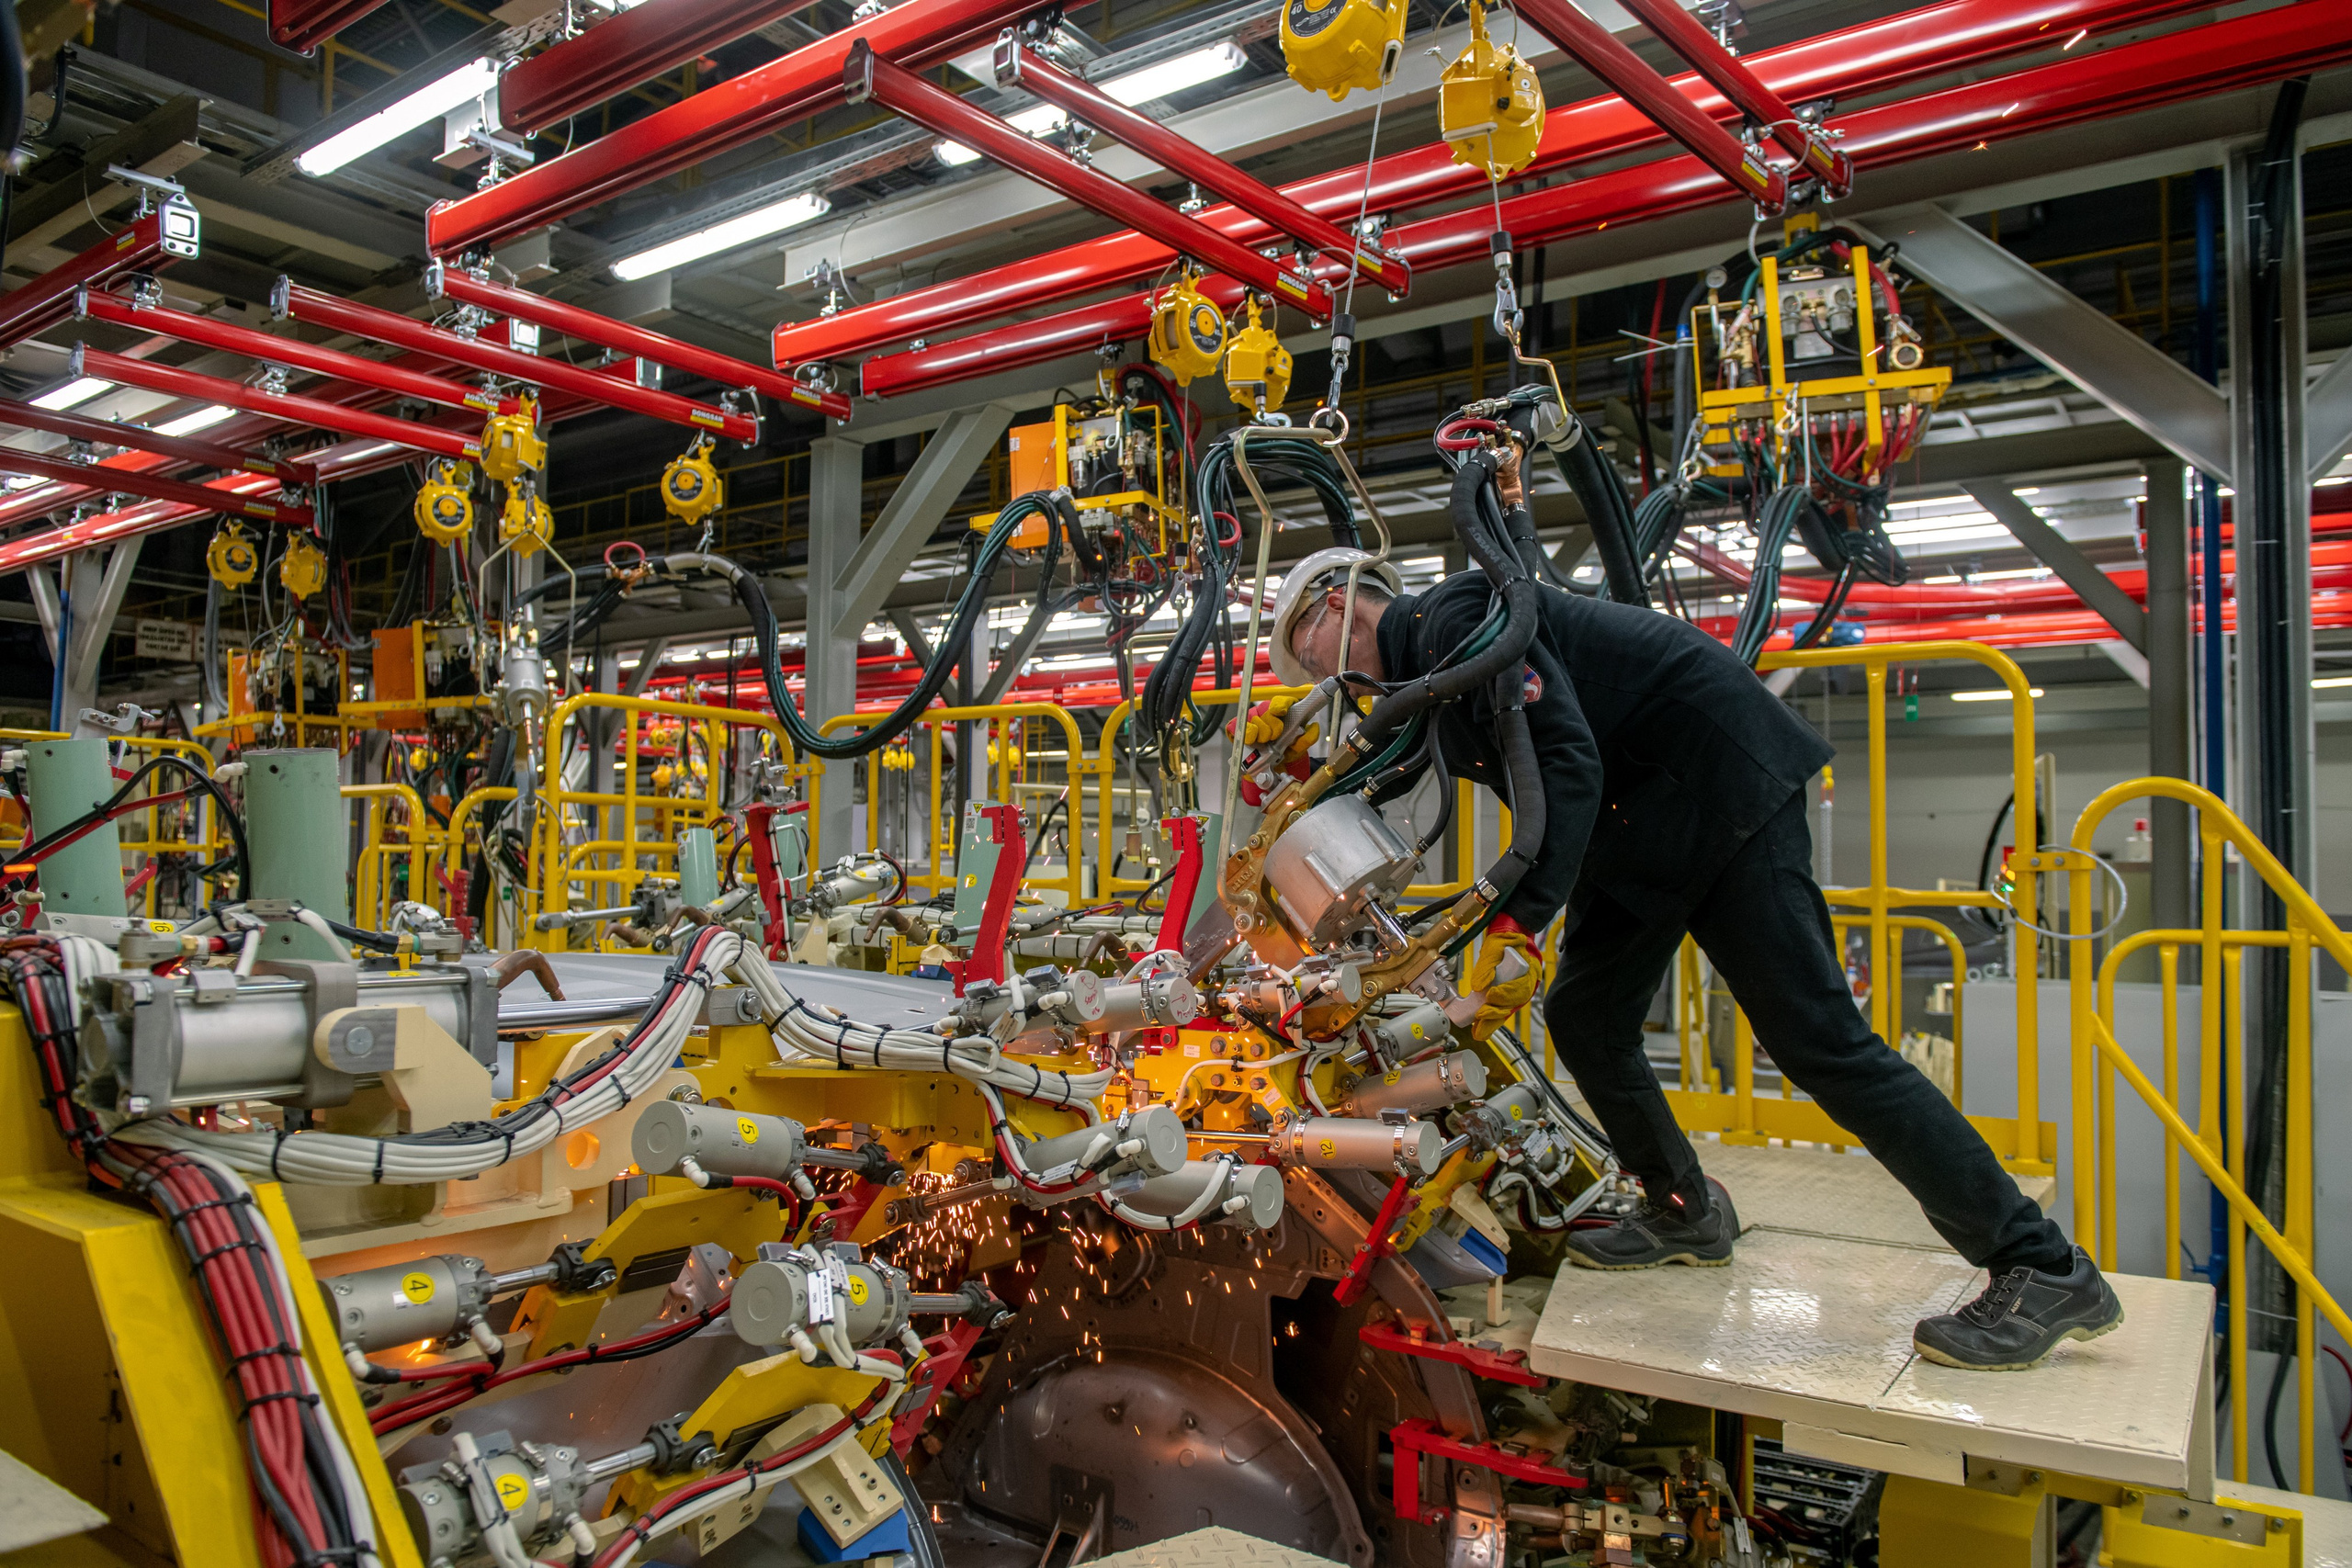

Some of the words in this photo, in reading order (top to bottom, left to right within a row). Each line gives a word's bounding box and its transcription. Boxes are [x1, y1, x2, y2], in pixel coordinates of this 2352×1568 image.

[1291, 5, 1302, 15] 40
[1278, 270, 1308, 293] DONGSAN
[792, 386, 822, 400] DONGSAN
[691, 408, 724, 423] DONGSAN
[153, 921, 171, 933] 16
[1386, 1071, 1399, 1083] 12
[741, 1122, 756, 1135] 5
[1320, 1142, 1334, 1157] 12
[408, 1280, 429, 1293] 4
[851, 1282, 865, 1296] 5
[500, 1483, 521, 1498] 4
